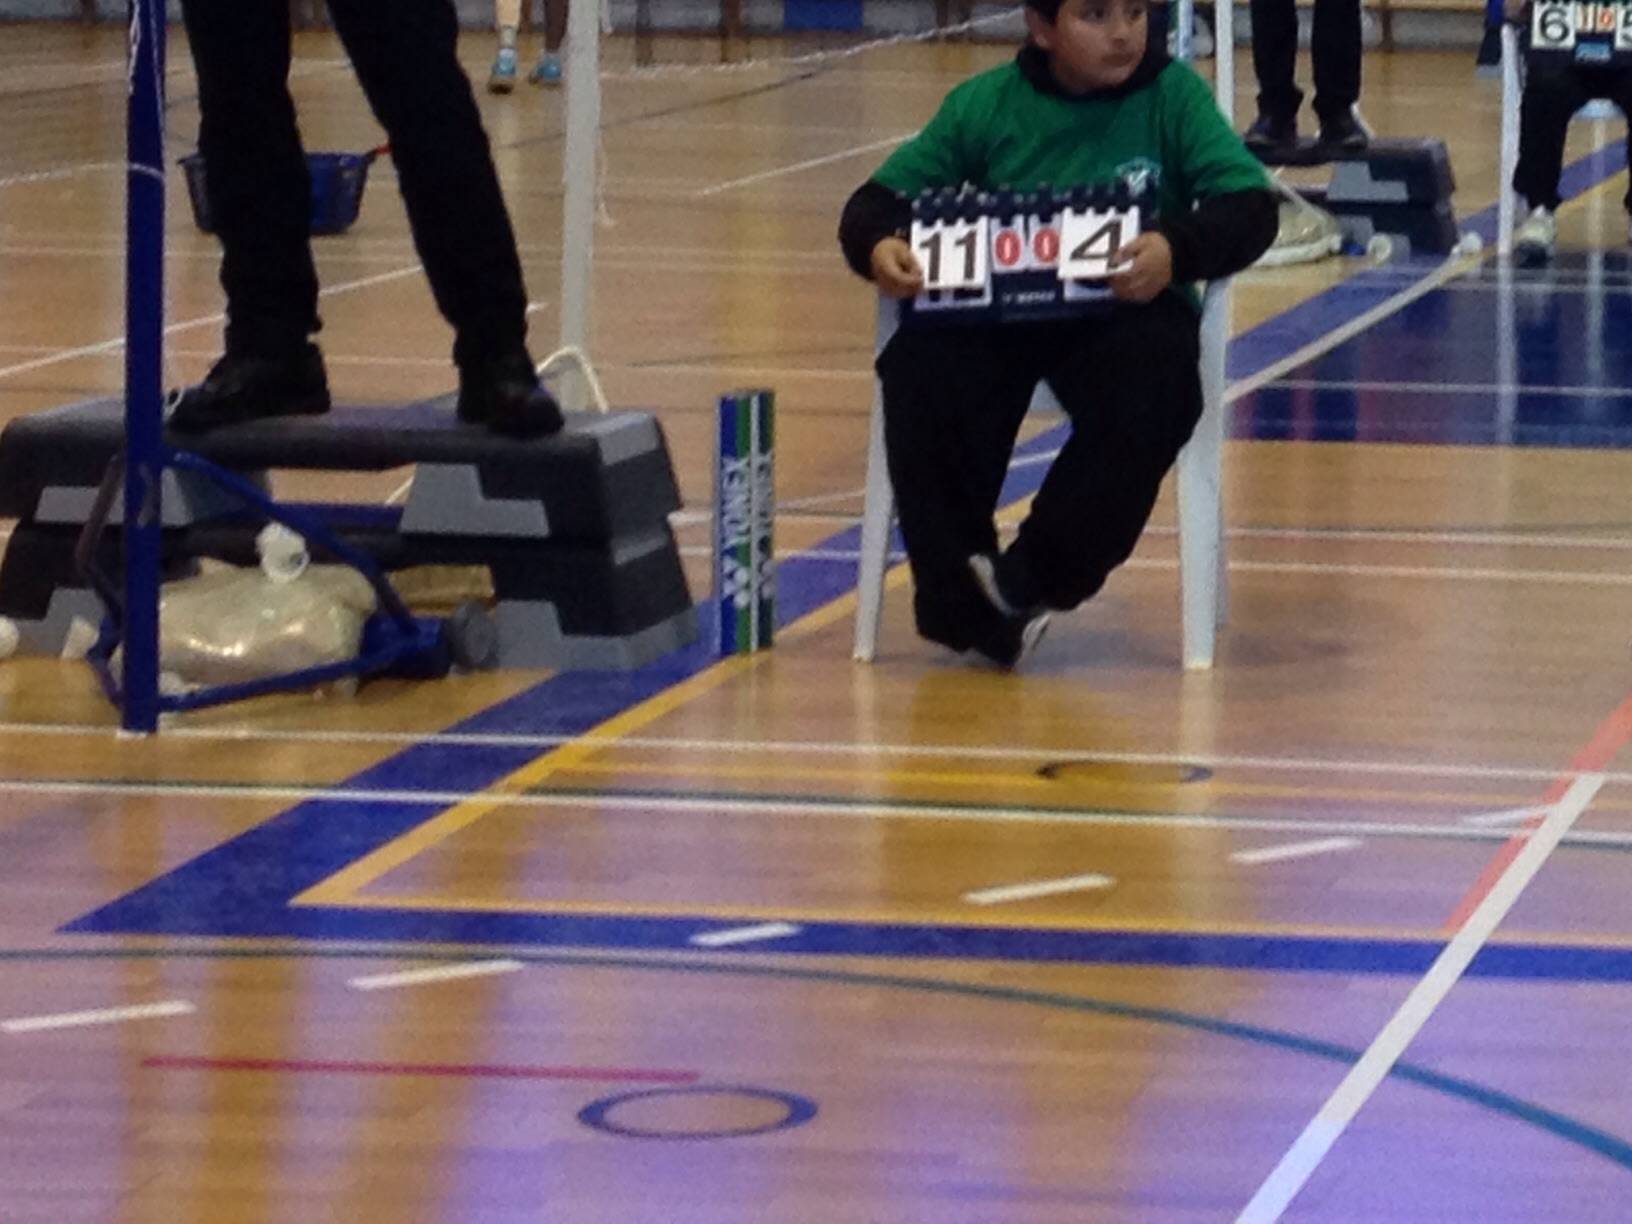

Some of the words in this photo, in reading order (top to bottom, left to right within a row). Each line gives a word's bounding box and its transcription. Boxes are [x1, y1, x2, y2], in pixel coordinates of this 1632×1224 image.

[1539, 7, 1570, 43] 6
[919, 229, 978, 283] 11
[1069, 217, 1124, 270] 4
